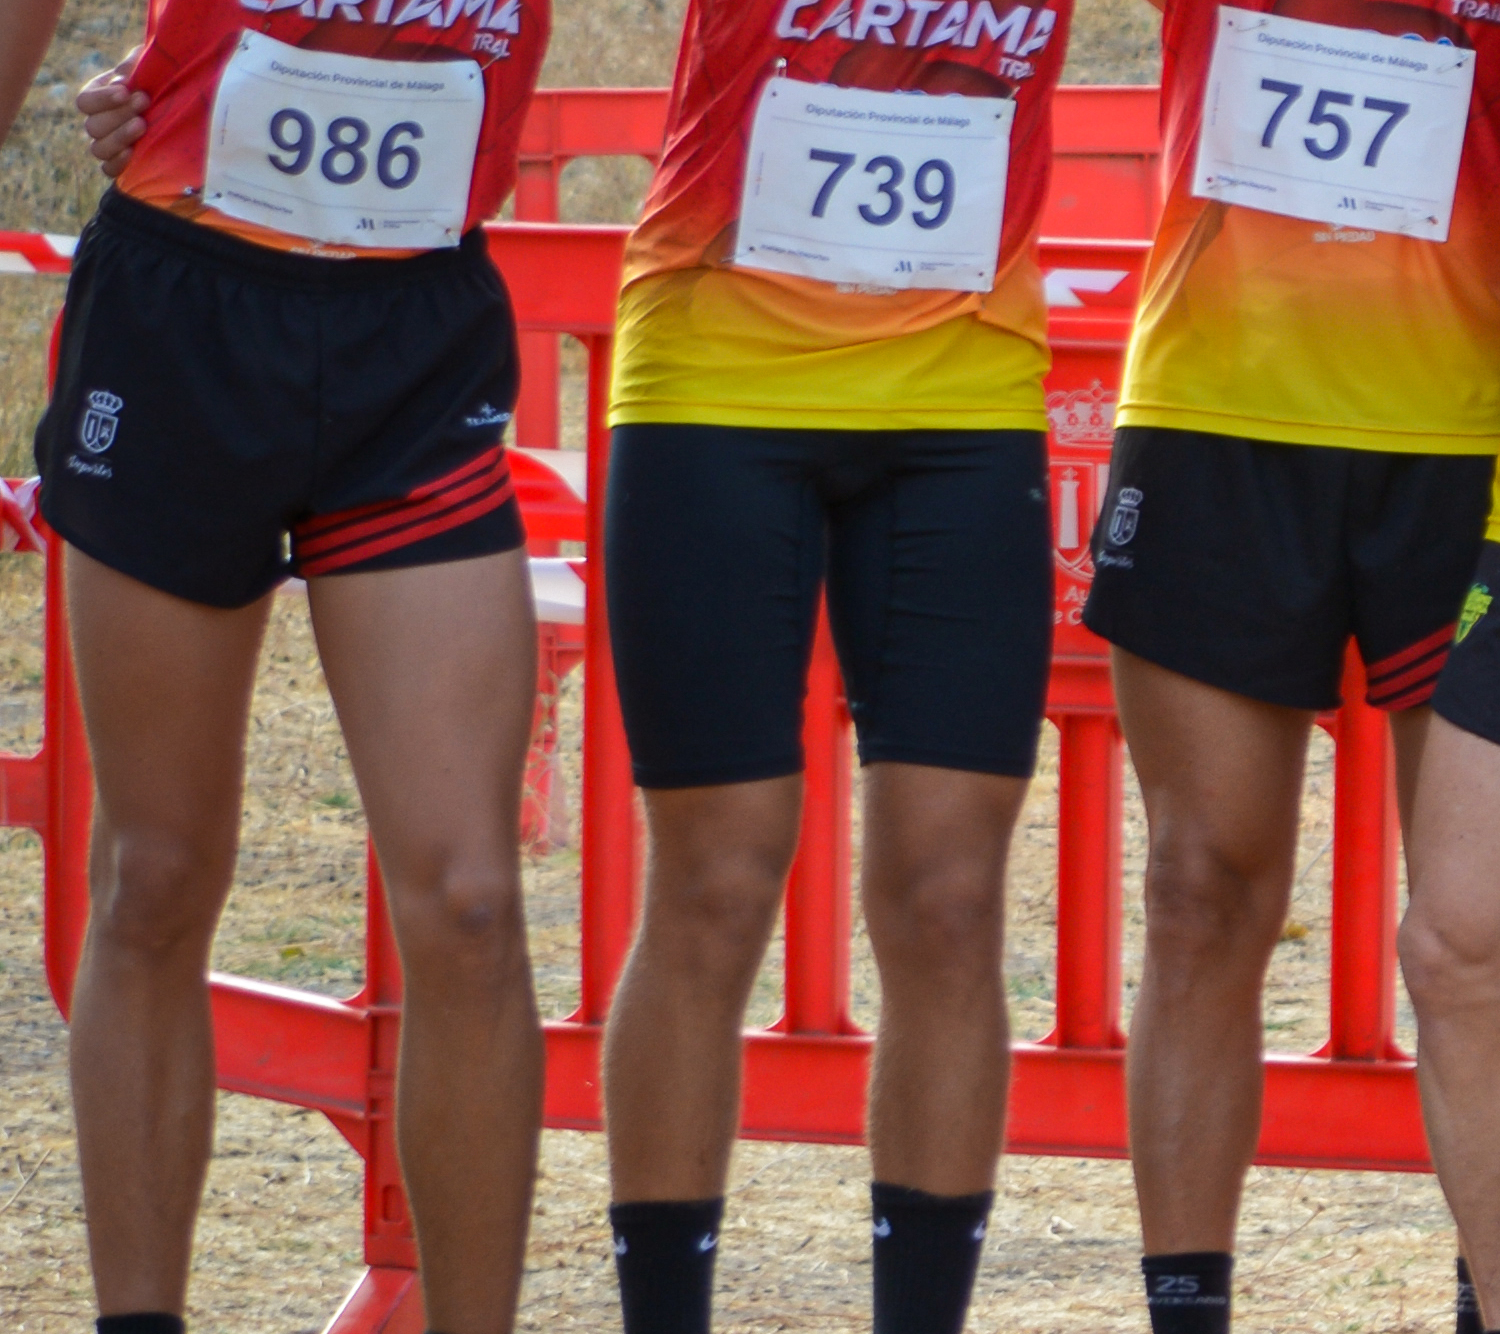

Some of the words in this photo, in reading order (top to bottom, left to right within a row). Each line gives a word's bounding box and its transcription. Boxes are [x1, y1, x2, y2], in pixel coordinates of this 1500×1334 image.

[270, 60, 330, 83] Diputación
[332, 72, 389, 89] Provincial
[390, 80, 404, 90] de
[1257, 31, 1315, 53] Diputación
[1315, 44, 1370, 62] Provincial
[1371, 54, 1385, 66] de
[267, 106, 425, 190] 986
[1260, 77, 1411, 168] 757
[809, 147, 957, 230] 739
[1155, 1275, 1200, 1294] 25
